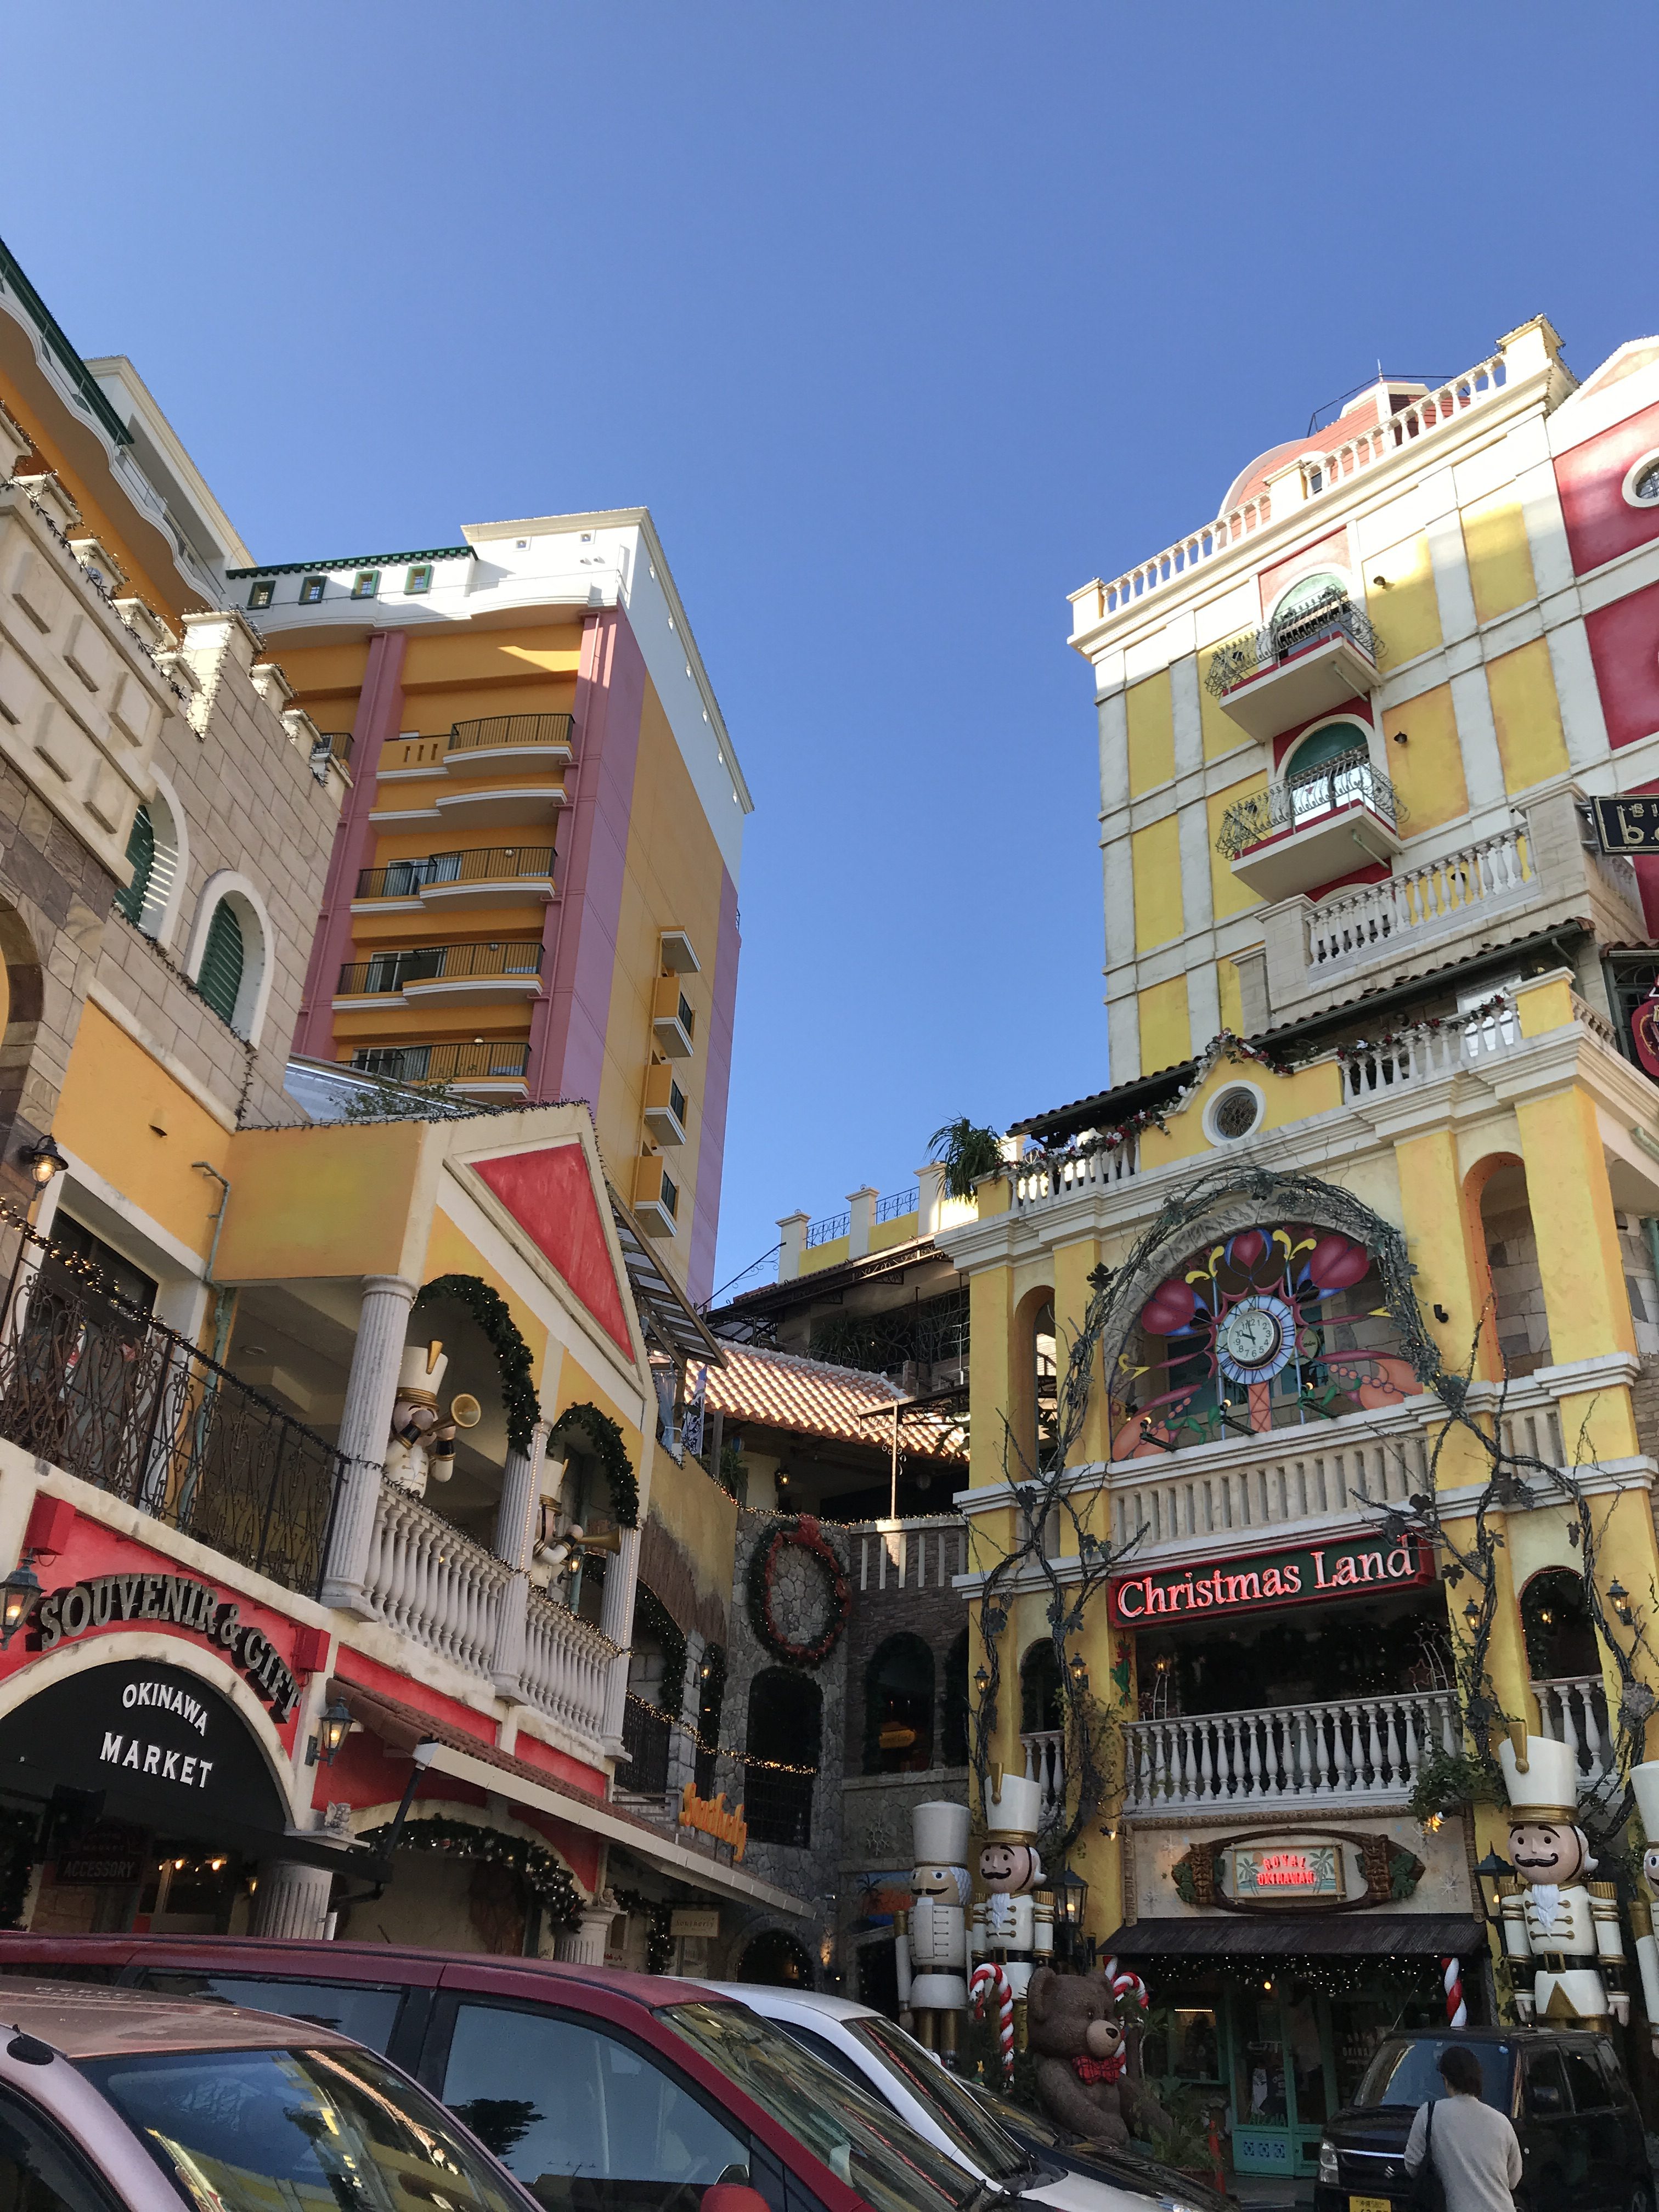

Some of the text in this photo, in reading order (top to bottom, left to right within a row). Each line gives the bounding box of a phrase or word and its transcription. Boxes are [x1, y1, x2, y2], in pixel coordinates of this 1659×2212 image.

[1235, 1329, 1244, 1338] 10
[1266, 1330, 1271, 1338] 3
[1238, 1345, 1244, 1353] 8
[1245, 1349, 1250, 1357] 7
[1251, 1350, 1257, 1358] 6
[1259, 1346, 1265, 1354] 5
[1118, 1534, 1415, 1618] Christmas Land
[40, 1573, 303, 1724] SOUVENIR & GIFT
[122, 1683, 208, 1737] OKINAWA
[99, 1731, 213, 1788] MARKET
[63, 1861, 135, 1878] ACCESSORY
[1263, 1854, 1306, 1871] ROYAL
[1256, 1870, 1315, 1885] OKINAWAN
